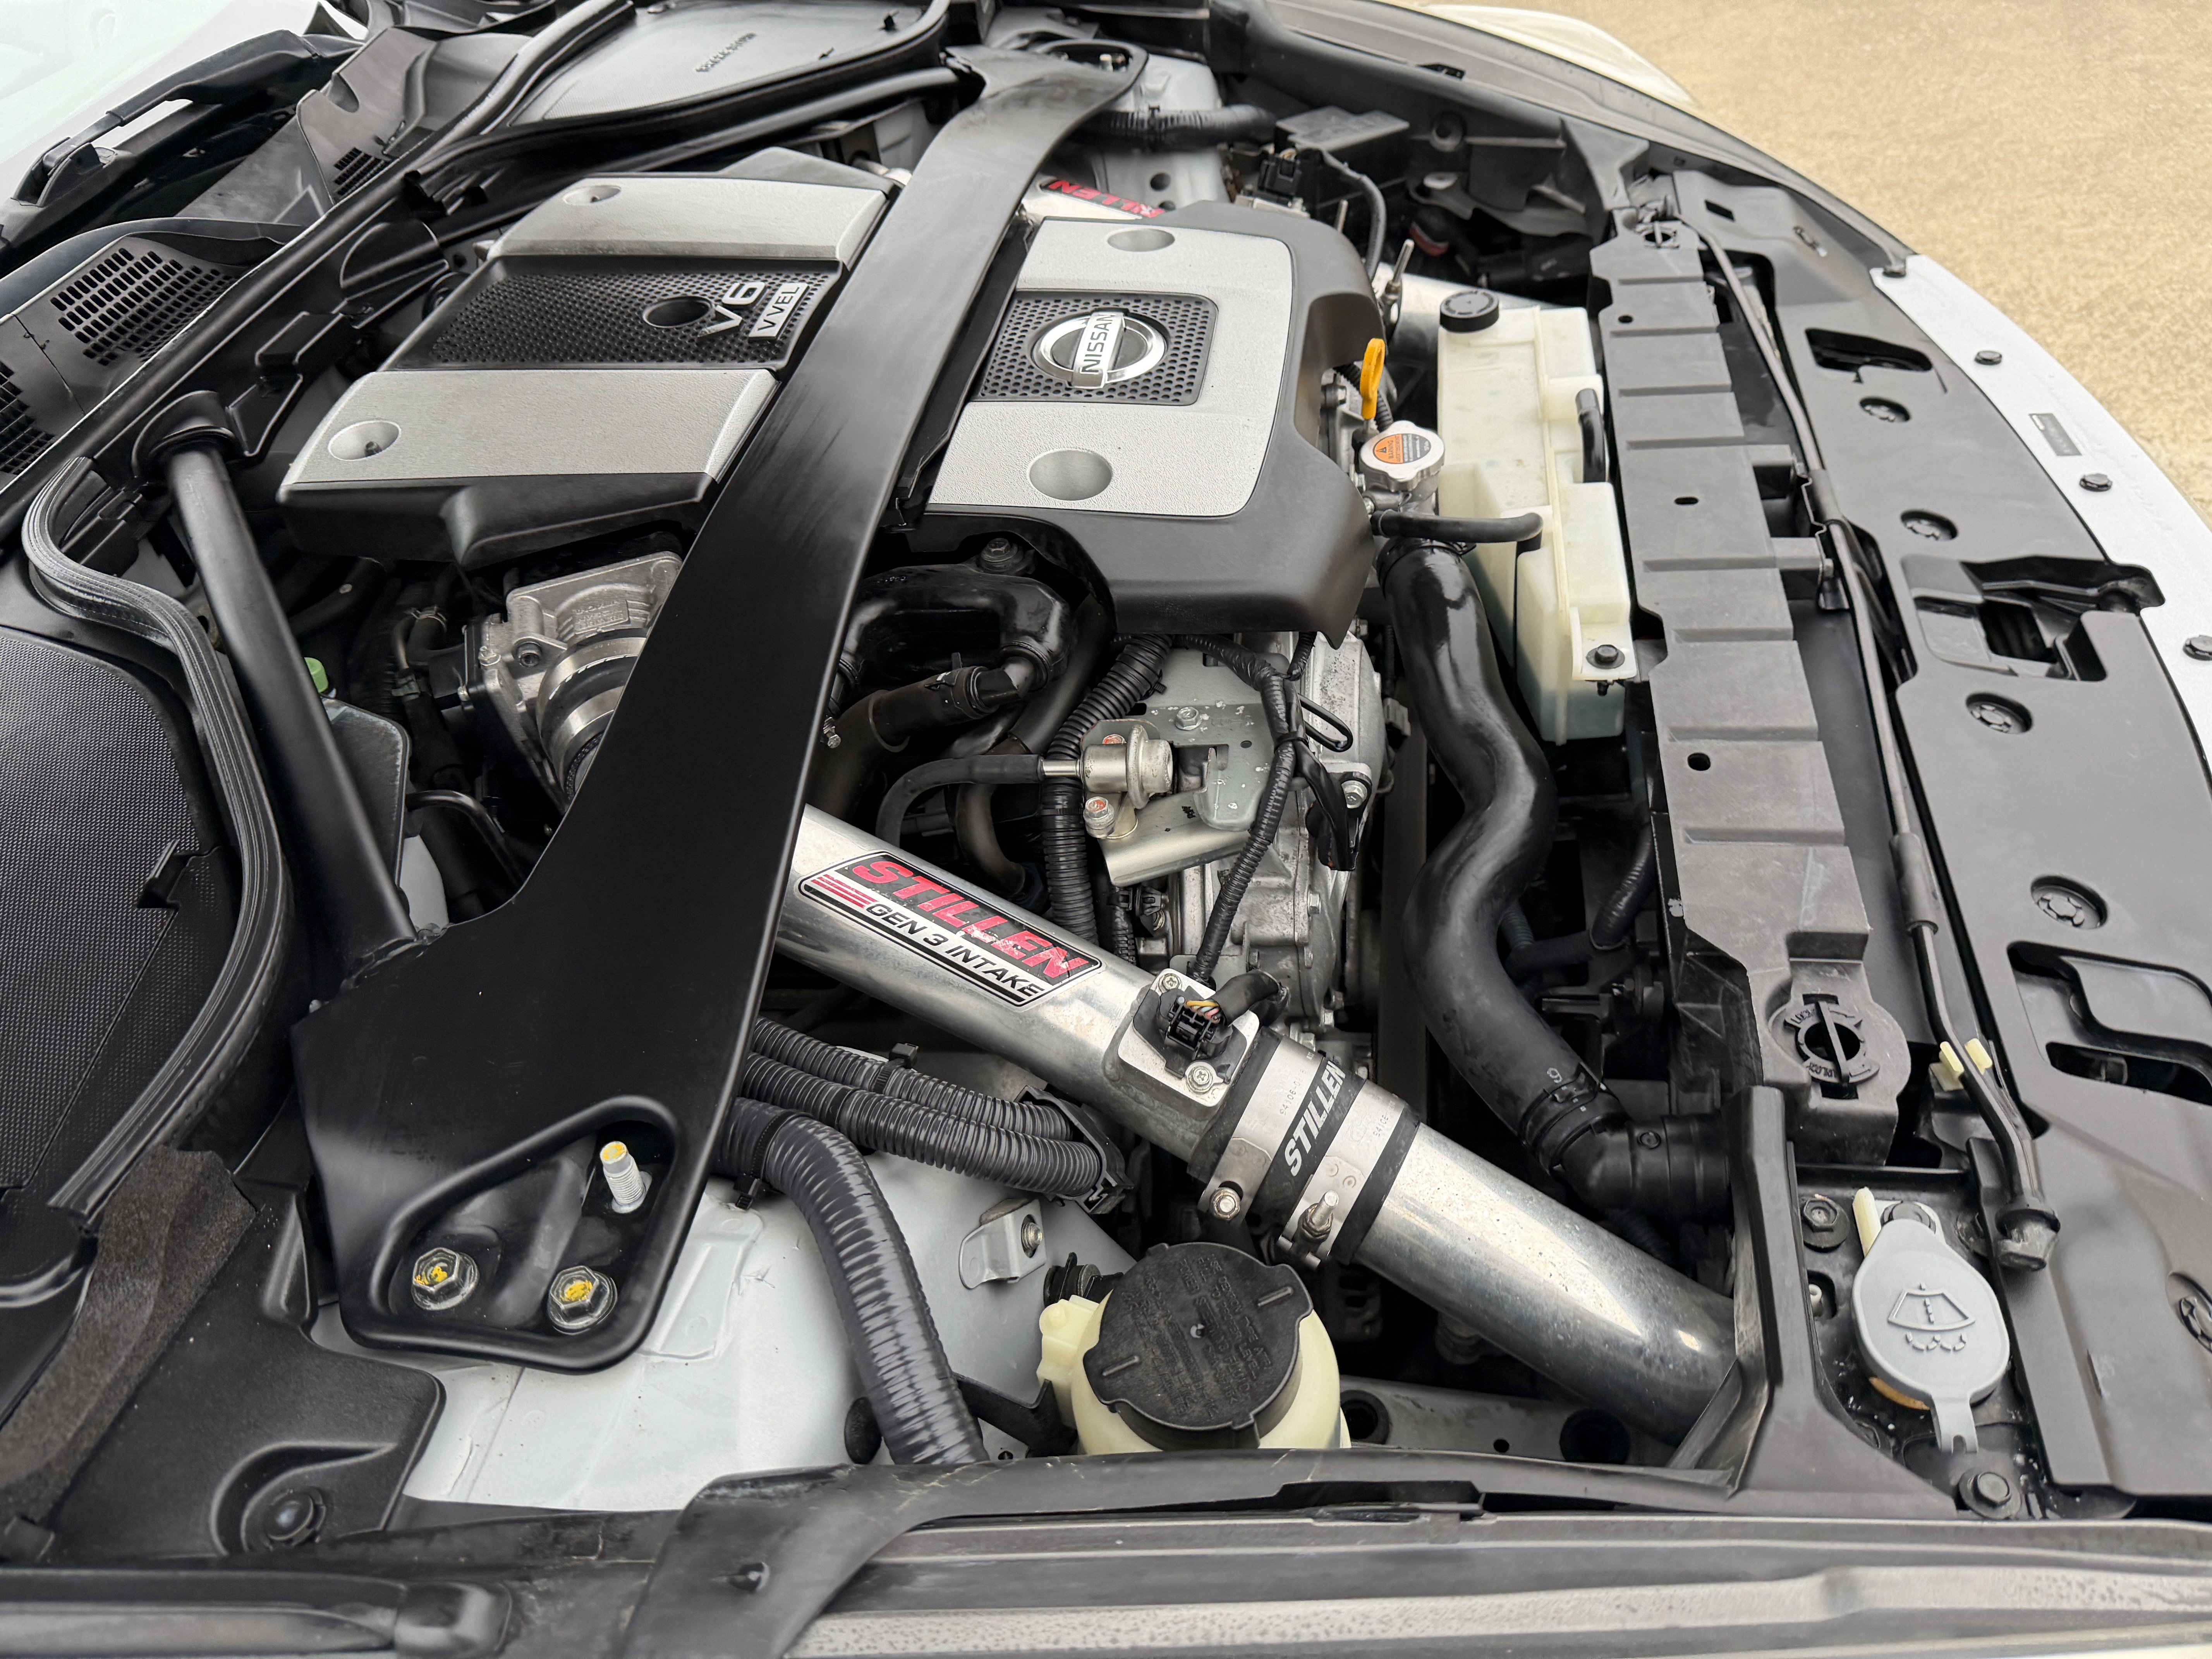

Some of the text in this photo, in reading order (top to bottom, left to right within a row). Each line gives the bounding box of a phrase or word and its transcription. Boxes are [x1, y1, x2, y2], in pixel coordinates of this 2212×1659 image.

[698, 282, 767, 337] V6
[757, 287, 801, 331] VVEL
[1081, 314, 1116, 373] NISSAN
[852, 860, 1089, 978] STILLEN
[866, 903, 1045, 997] GEN 3 INTAKE
[1285, 1060, 1346, 1176] STILLEN
[1176, 1259, 1200, 1293] POWER
[1238, 1341, 1262, 1379] LEVEL
